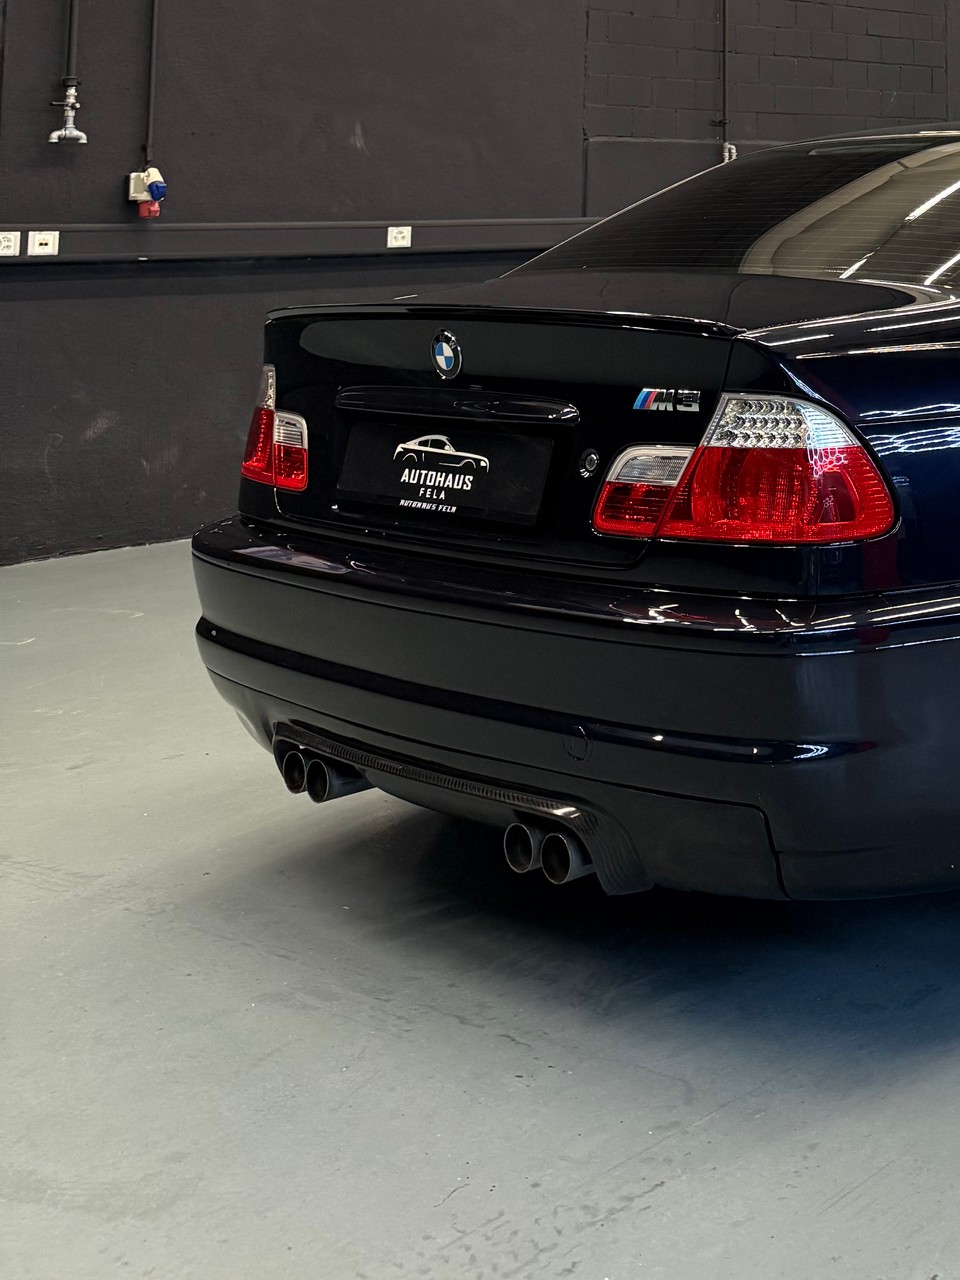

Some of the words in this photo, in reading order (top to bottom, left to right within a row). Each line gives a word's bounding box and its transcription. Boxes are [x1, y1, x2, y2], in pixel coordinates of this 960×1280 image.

[646, 388, 701, 412] M3
[400, 468, 474, 491] AUTOHAUS
[419, 487, 445, 500] FELA
